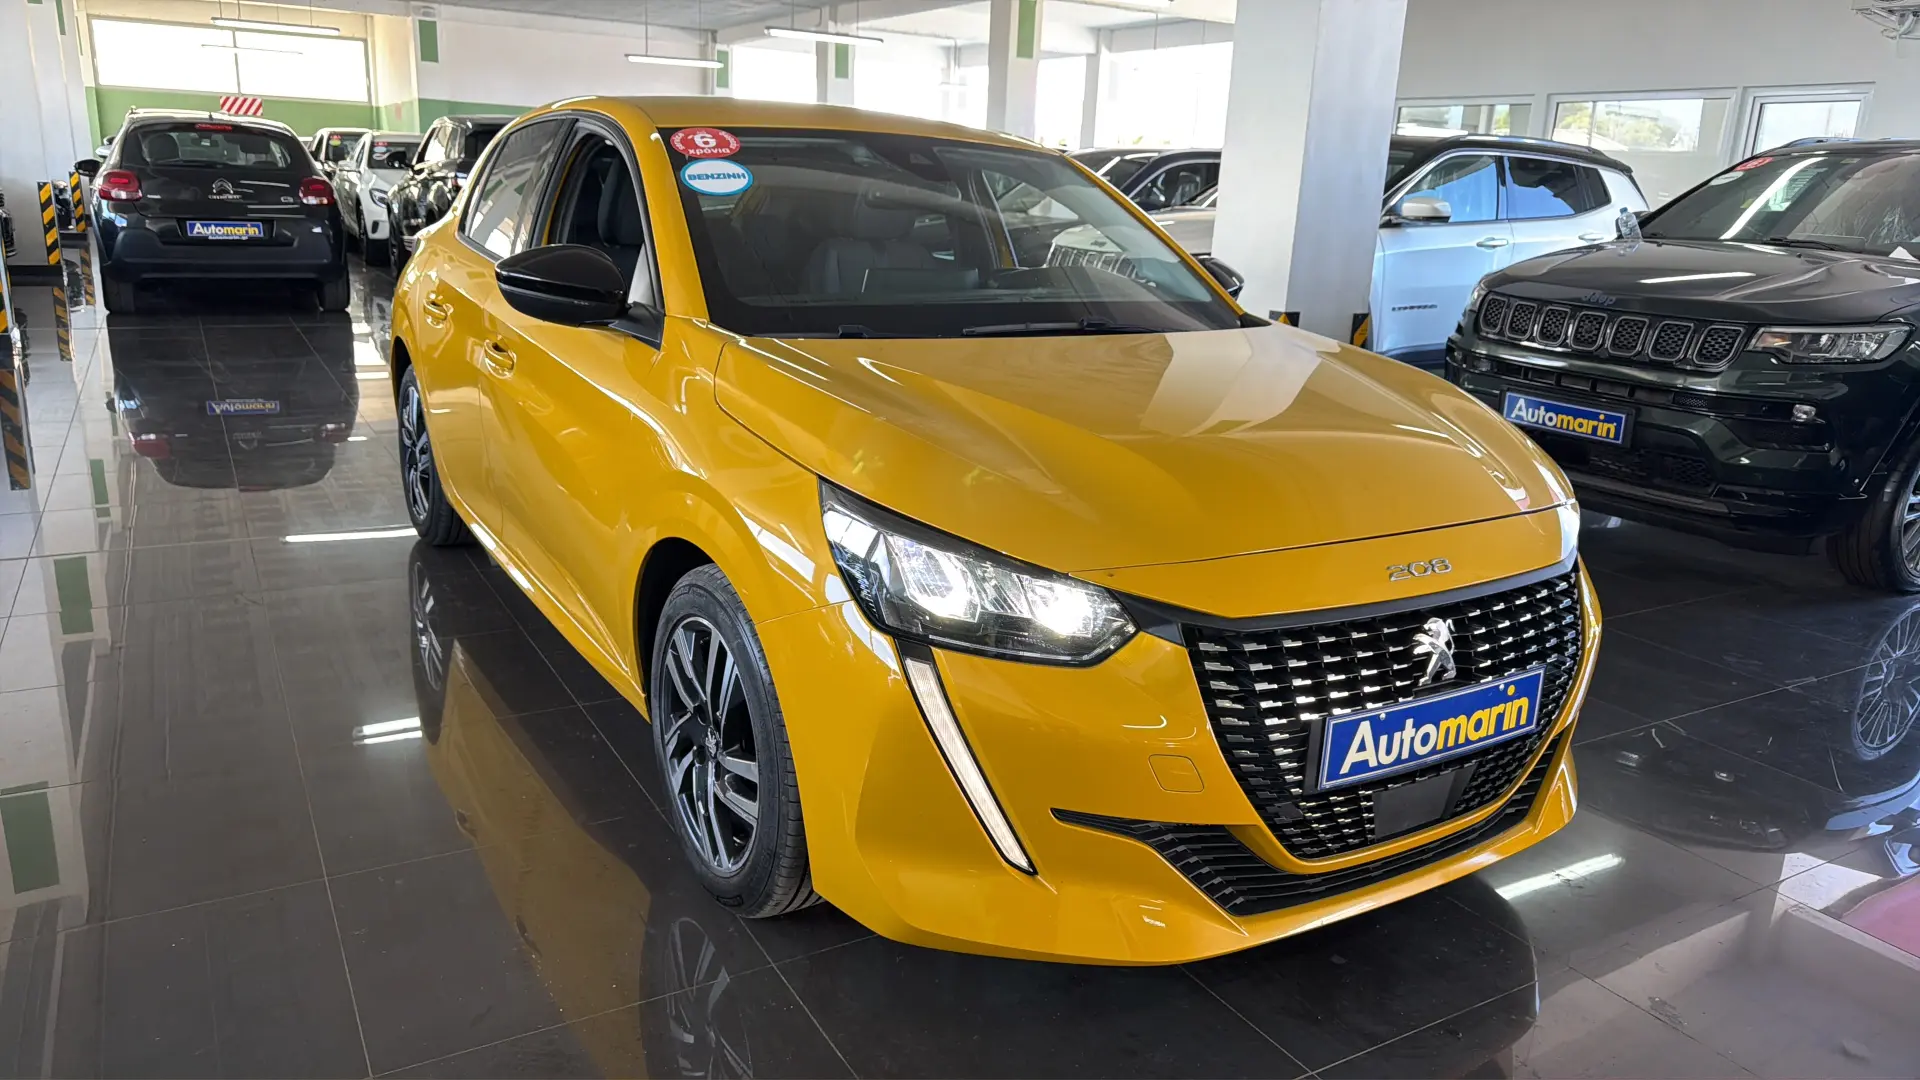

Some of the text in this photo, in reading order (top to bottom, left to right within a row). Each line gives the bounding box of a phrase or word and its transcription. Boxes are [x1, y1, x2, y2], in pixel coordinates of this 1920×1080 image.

[694, 133, 717, 148] 6
[688, 147, 731, 155] χρόνια
[193, 222, 259, 235] Automarin
[1511, 398, 1617, 439] Automarin
[1387, 558, 1452, 581] 208
[1339, 684, 1529, 775] Automarin
